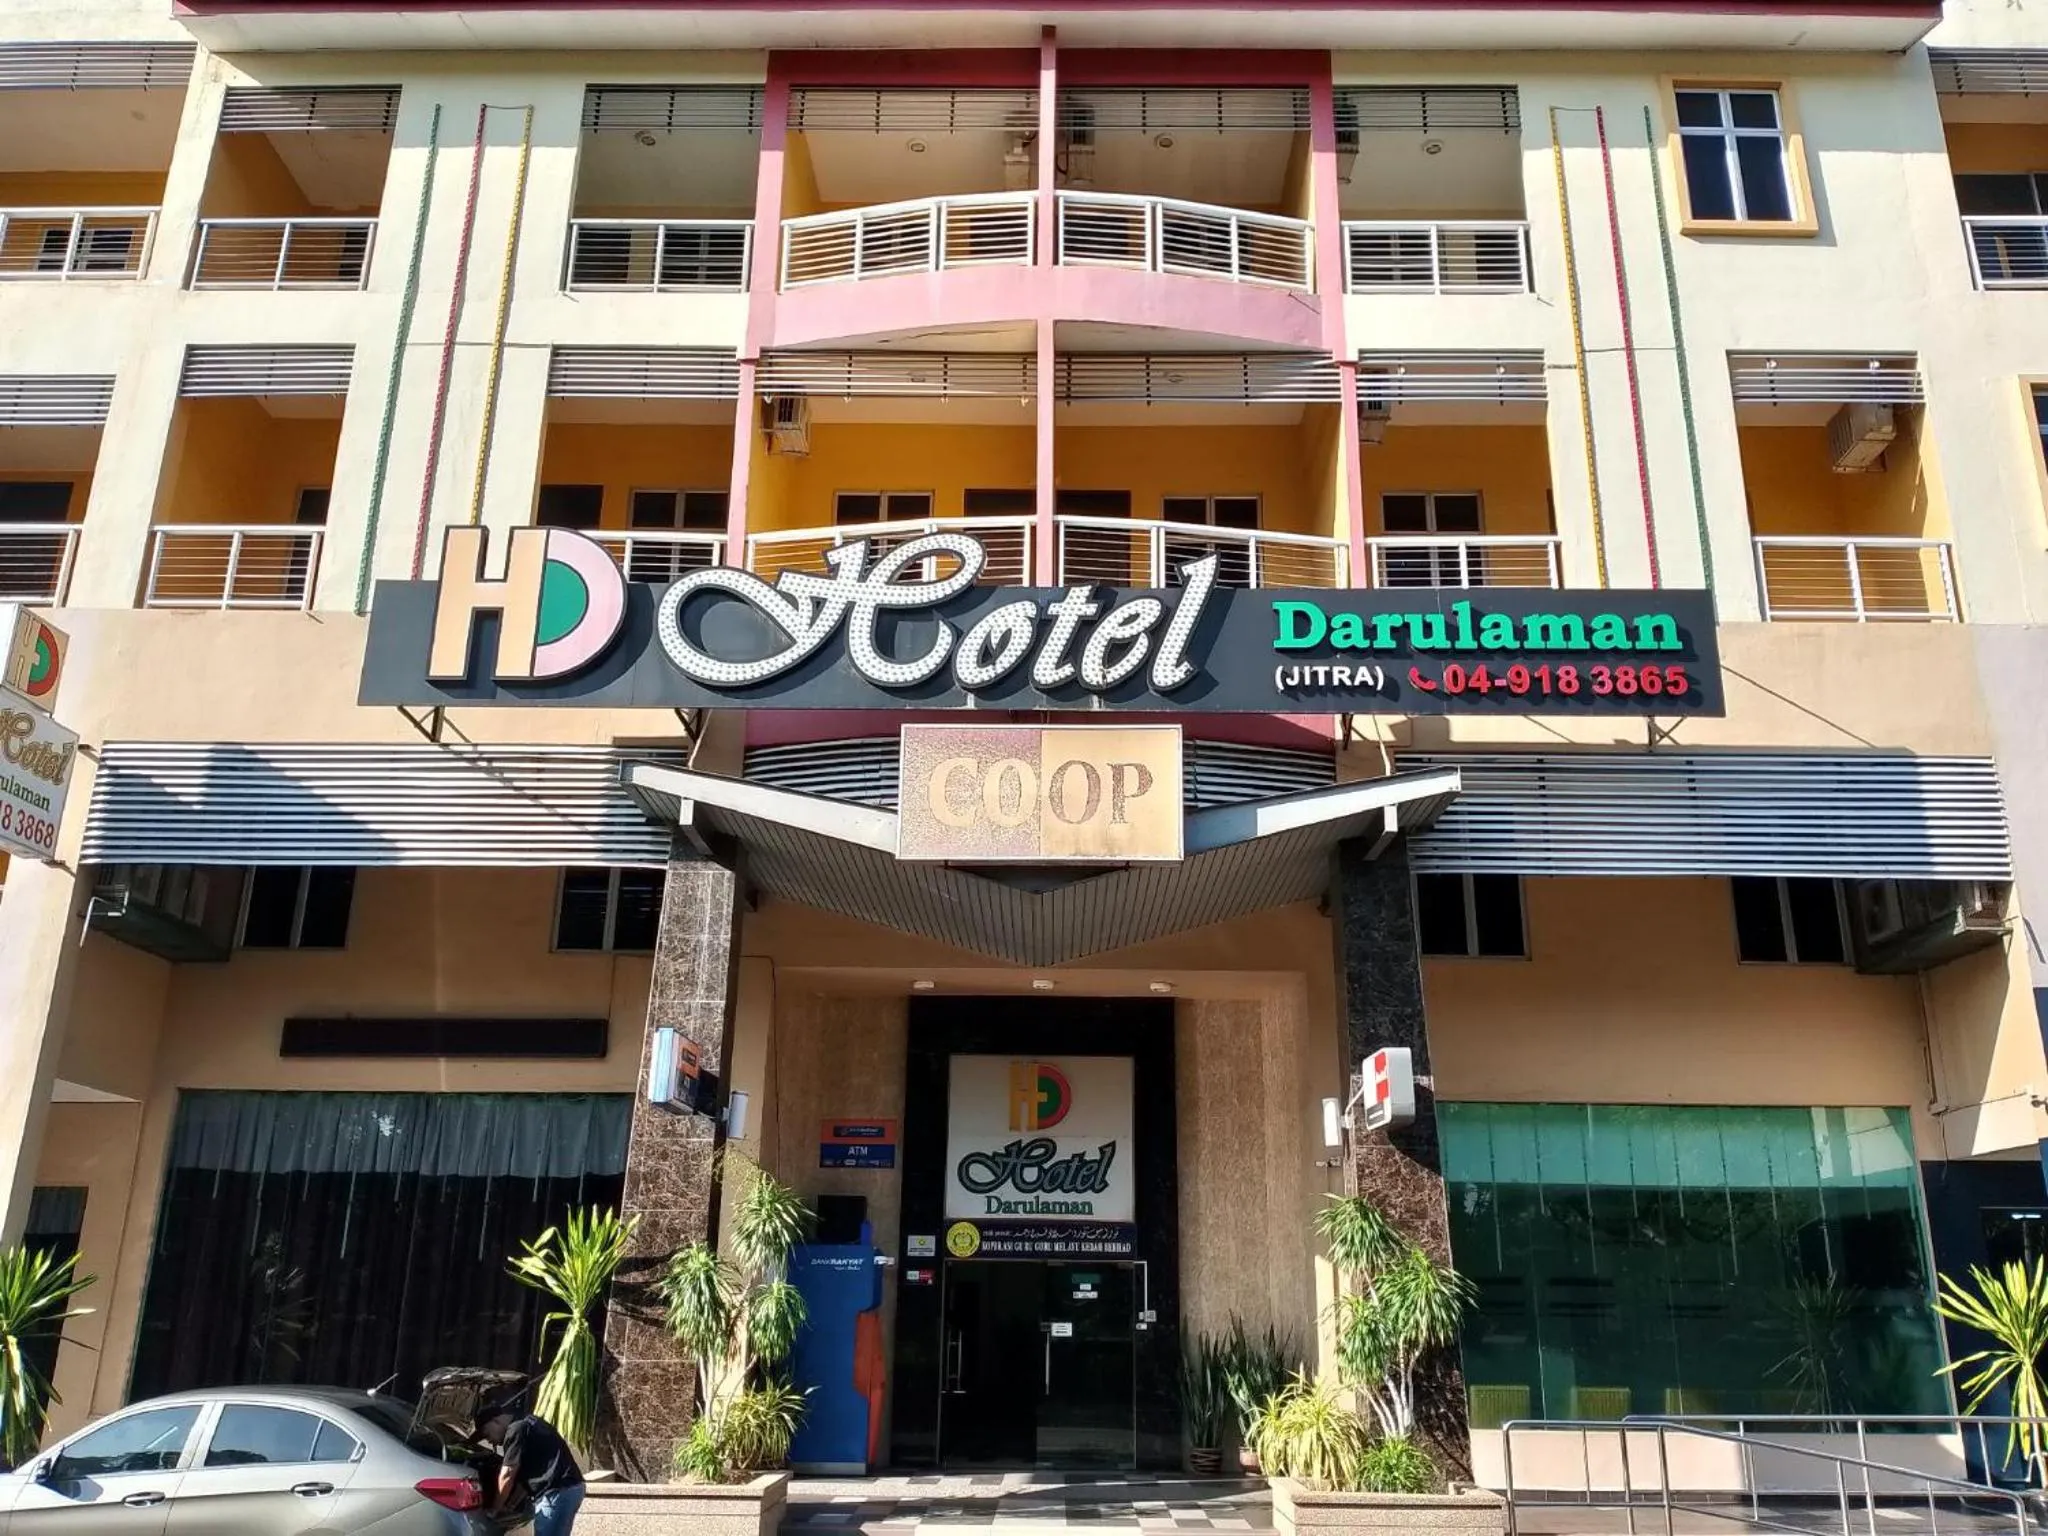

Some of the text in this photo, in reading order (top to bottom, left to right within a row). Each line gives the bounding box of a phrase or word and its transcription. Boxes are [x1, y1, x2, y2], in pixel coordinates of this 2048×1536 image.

[656, 532, 1220, 691] Hotel
[1272, 601, 1683, 650] Darulaman
[1275, 664, 1688, 696] (JITRA) 04-918 3865
[14, 808, 54, 848] 3868
[848, 1146, 868, 1156] ATM
[957, 1138, 1116, 1194] Hotel
[985, 1196, 1093, 1215] Darulaman
